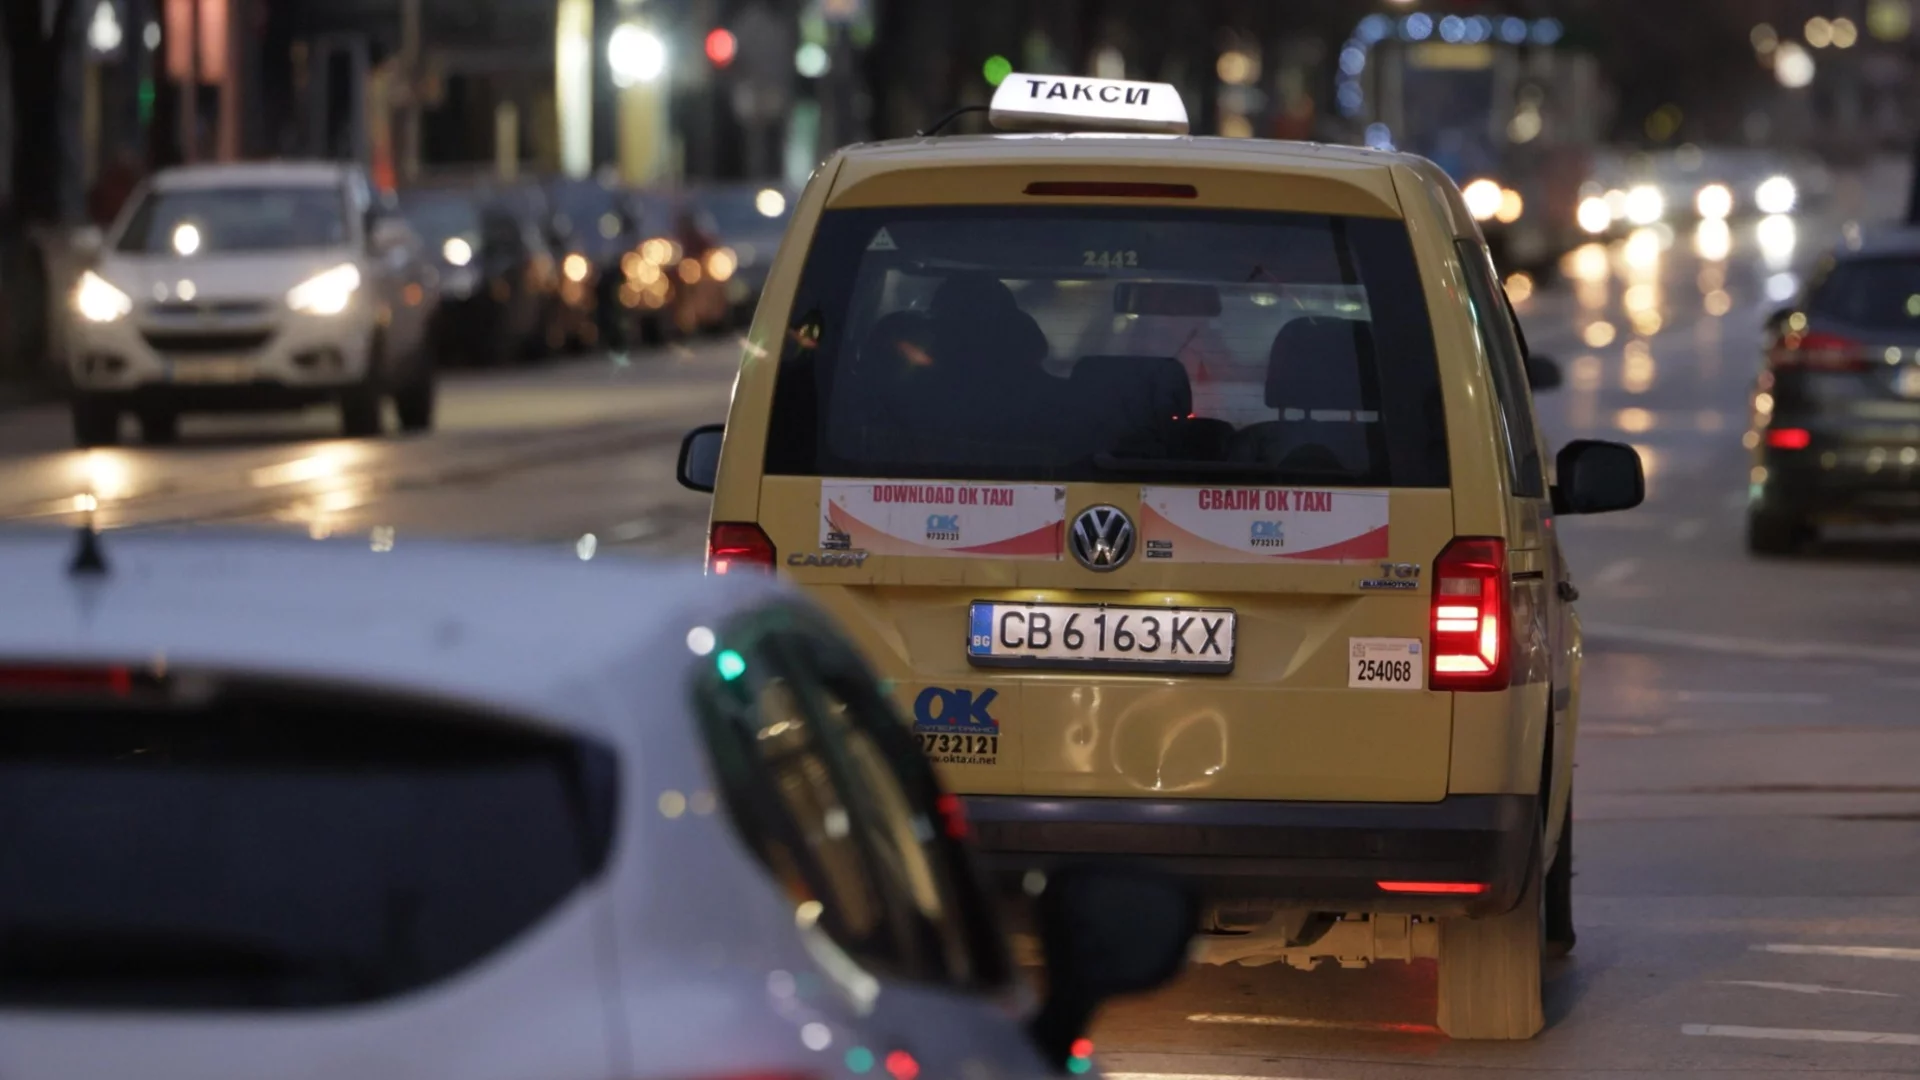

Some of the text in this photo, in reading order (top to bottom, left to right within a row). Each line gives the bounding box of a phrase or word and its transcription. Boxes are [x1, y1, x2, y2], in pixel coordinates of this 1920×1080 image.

[1026, 79, 1150, 106] ТАКСИ
[1083, 250, 1138, 268] 2442
[873, 485, 1014, 507] DOWNLOAD OK TAXI
[1198, 488, 1260, 510] СВАЛИ
[1293, 491, 1332, 512] TAXI
[926, 532, 959, 541] 9732121
[1250, 539, 1284, 547] 9732121
[787, 552, 869, 569] CADDY
[1381, 563, 1420, 578] TGI
[973, 635, 990, 647] BG
[1000, 611, 1225, 654] CB 6163 KX
[1358, 660, 1411, 682] 254068
